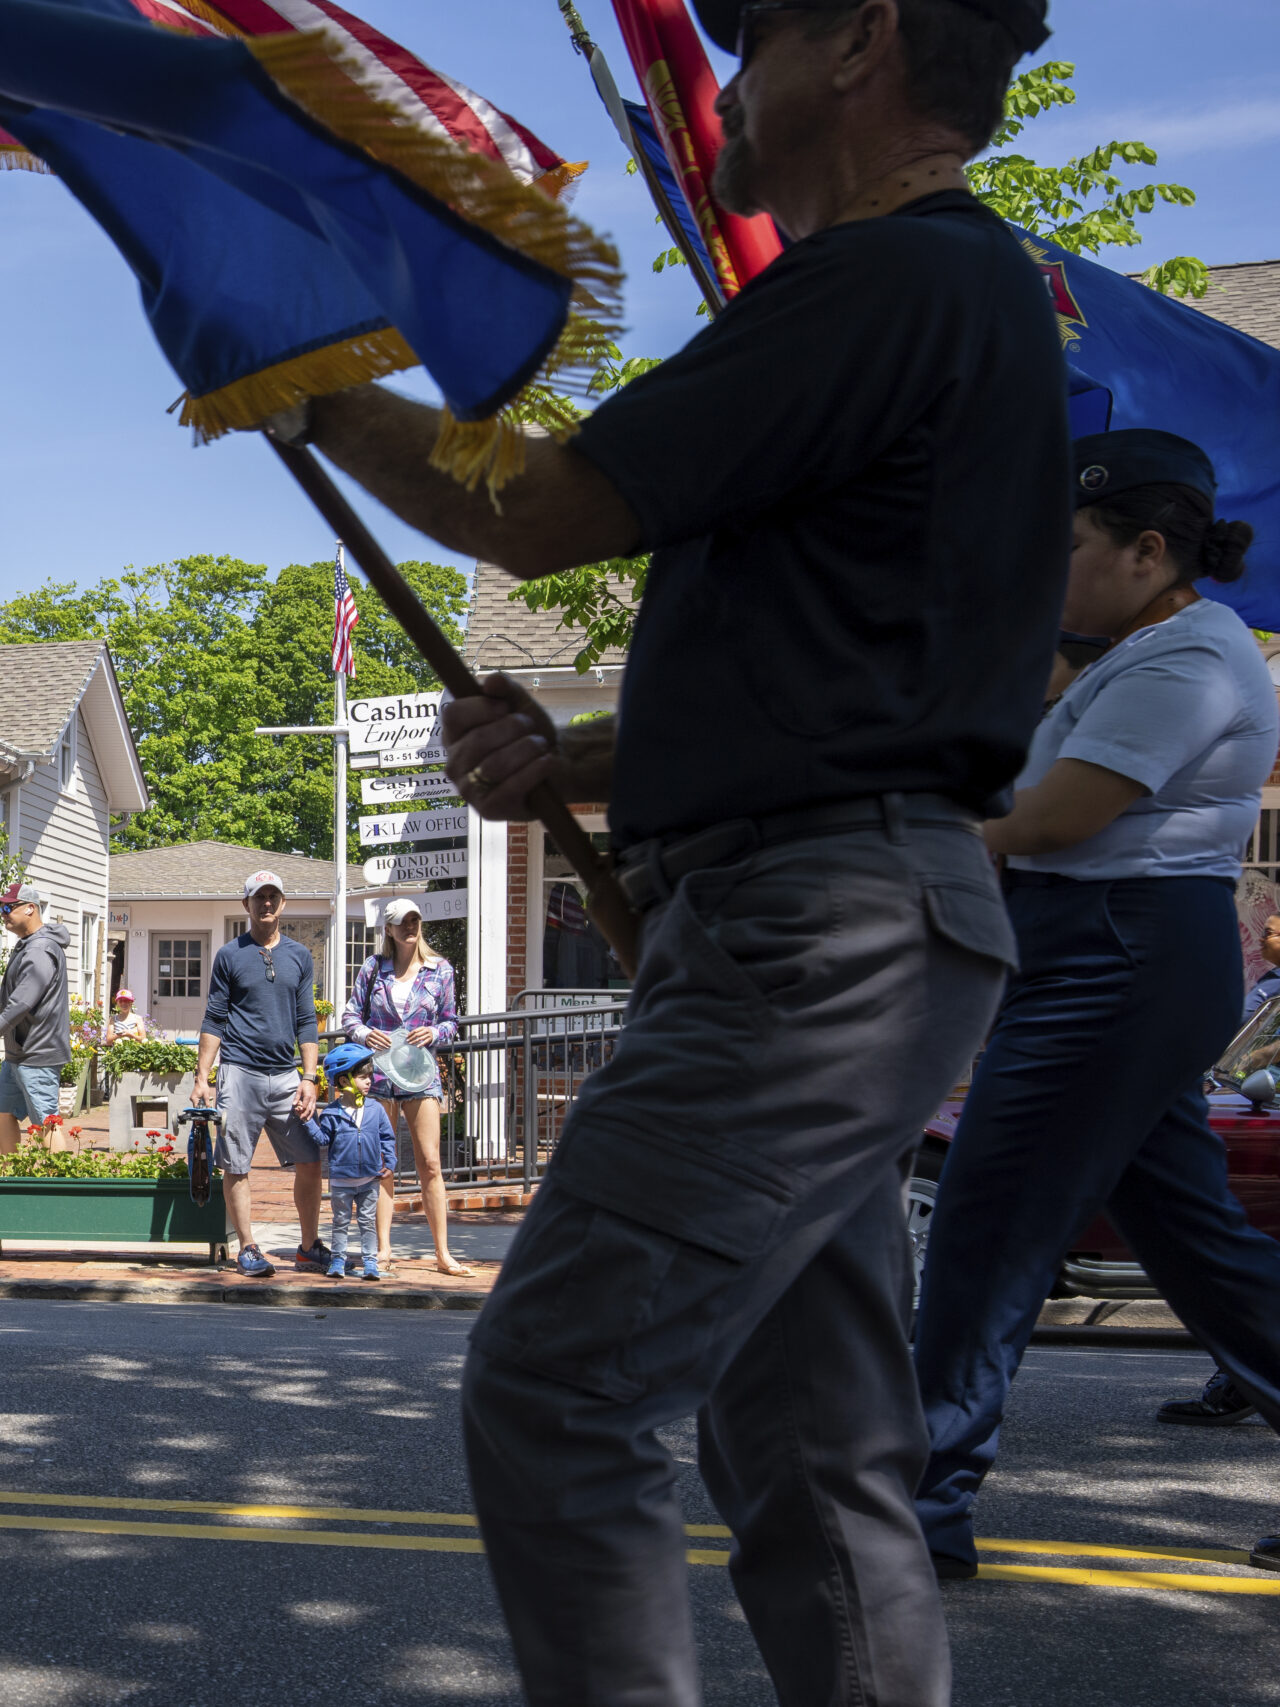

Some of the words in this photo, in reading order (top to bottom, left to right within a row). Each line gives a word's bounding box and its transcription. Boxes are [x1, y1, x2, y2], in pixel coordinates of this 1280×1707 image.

[384, 754, 394, 762] 43
[402, 753, 412, 761] 51
[415, 750, 440, 760] JOBS
[393, 788, 451, 800] Emporium
[392, 821, 421, 835] LAW
[425, 816, 468, 832] OFFIC
[376, 855, 429, 870] HOUND
[397, 864, 450, 880] DESIGN
